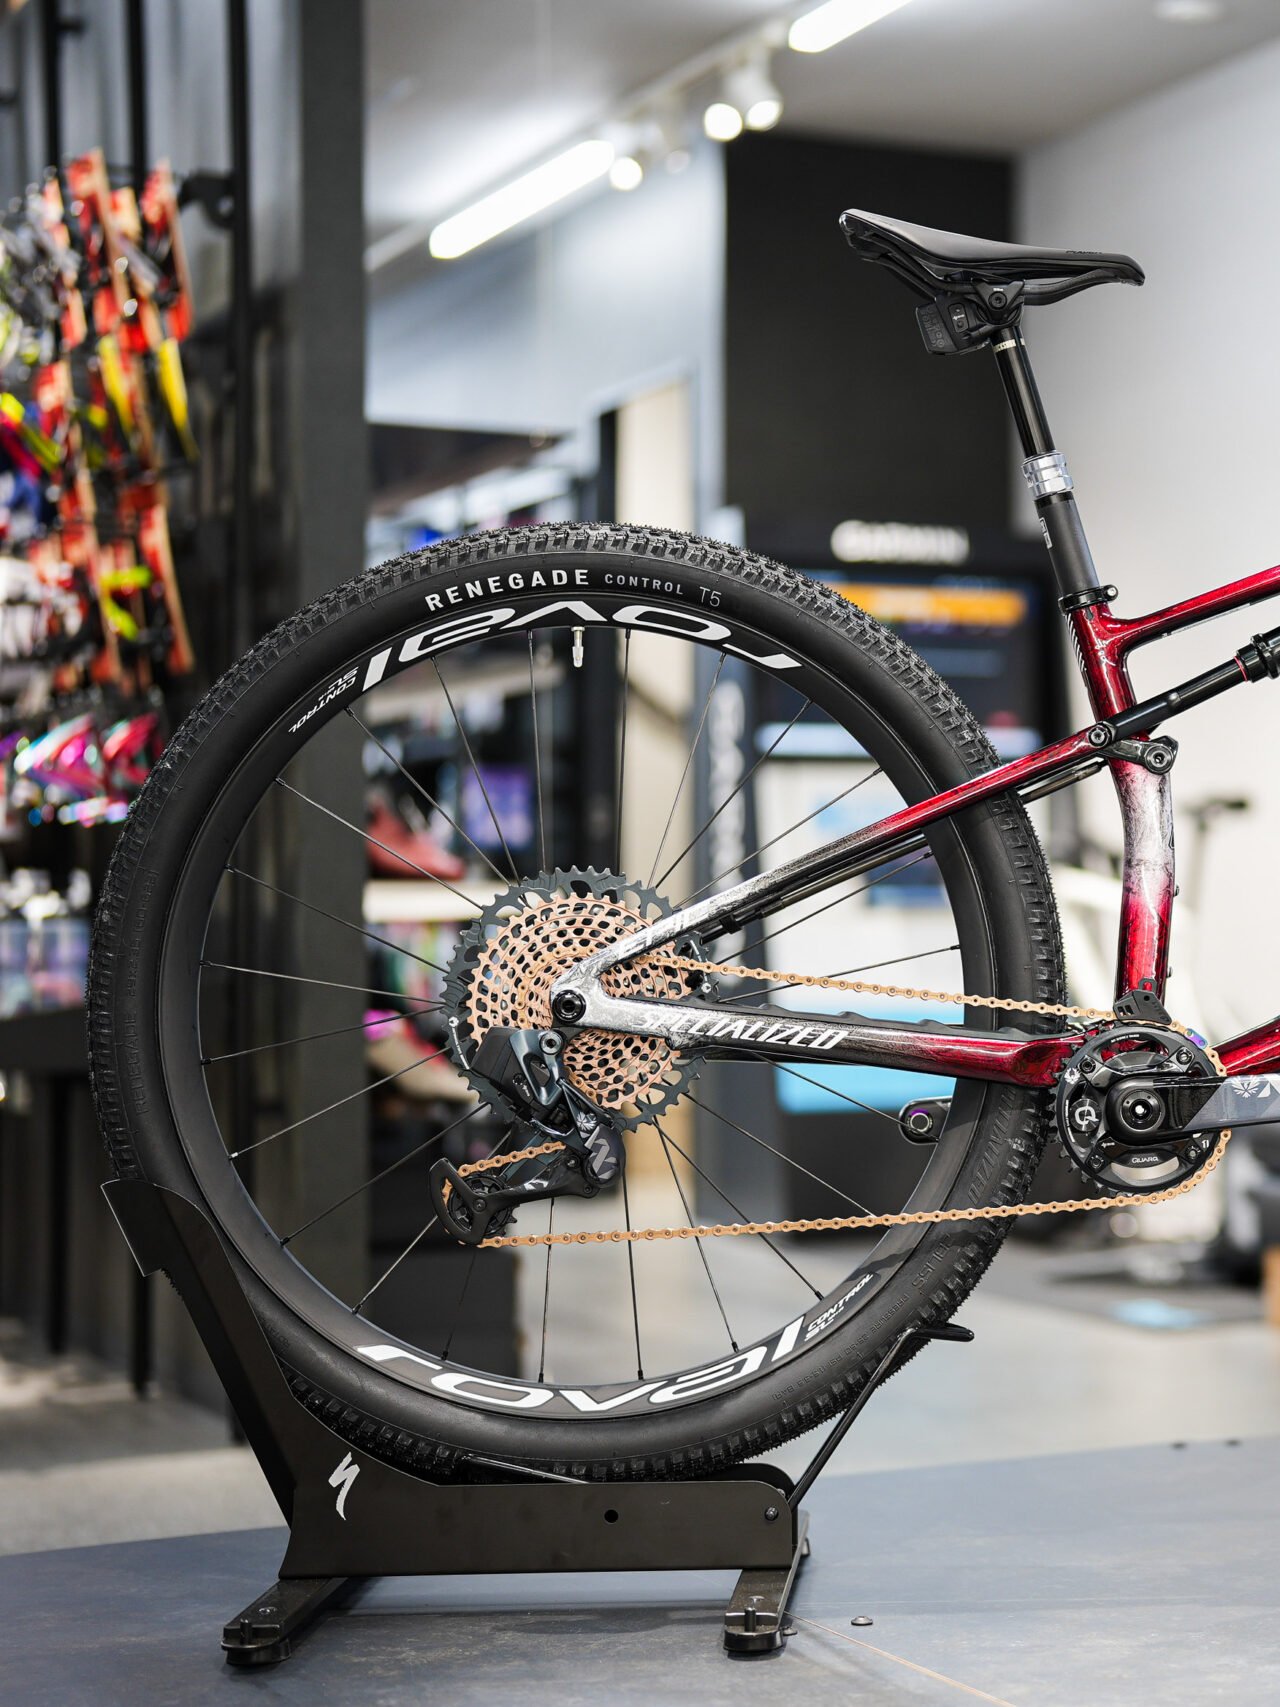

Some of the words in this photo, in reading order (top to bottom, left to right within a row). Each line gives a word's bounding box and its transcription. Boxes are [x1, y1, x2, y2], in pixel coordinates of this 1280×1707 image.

[425, 569, 590, 612] RENEGADE
[604, 573, 684, 596] CONTROL
[699, 586, 723, 608] T5
[288, 676, 356, 733] CONTROL
[631, 1011, 849, 1050] SPECIALIZED
[1131, 1155, 1159, 1164] QUARQ
[808, 1273, 874, 1332] CONTROL
[356, 1315, 804, 1412] roval
